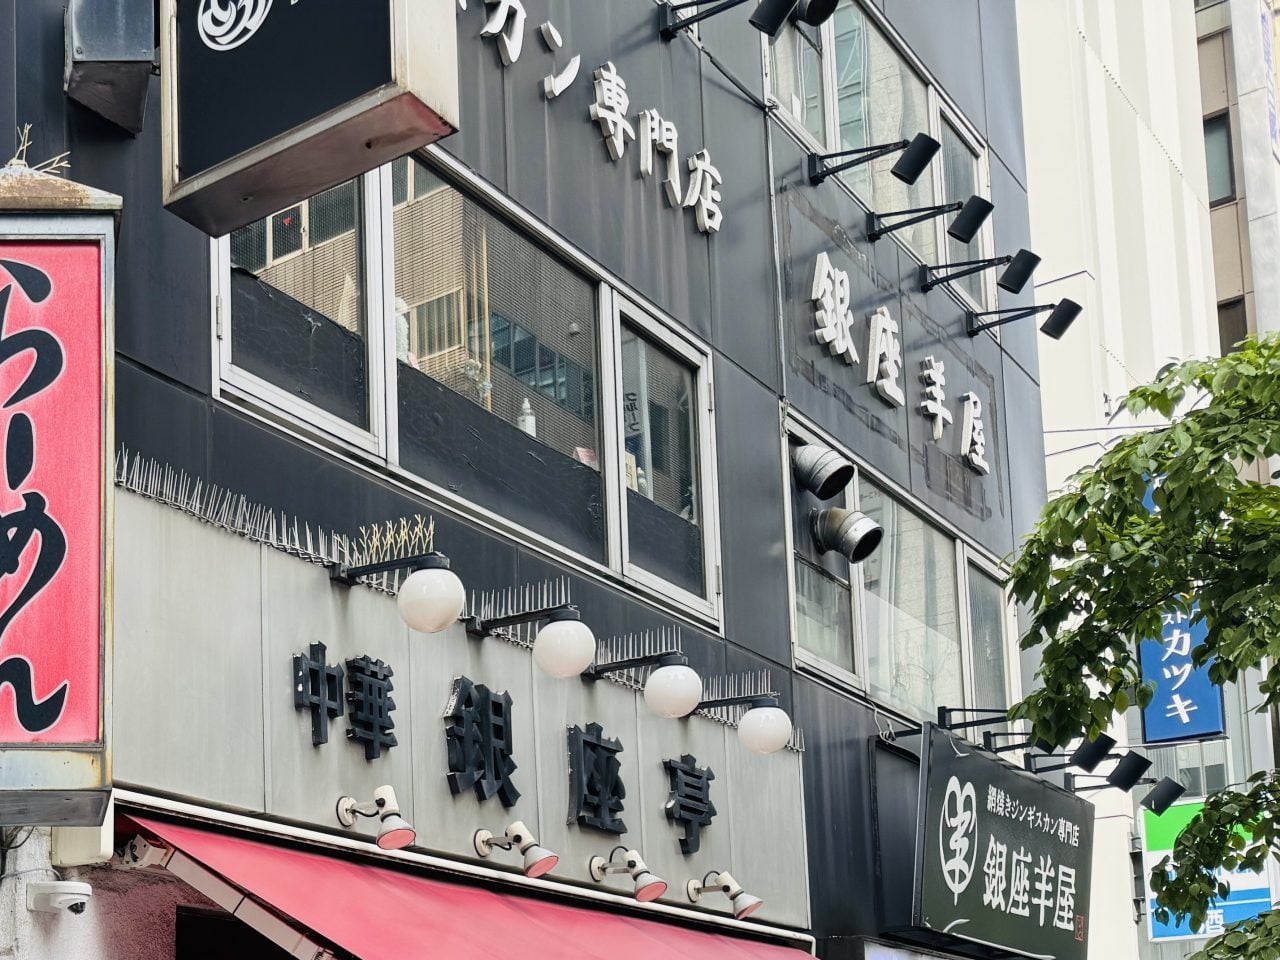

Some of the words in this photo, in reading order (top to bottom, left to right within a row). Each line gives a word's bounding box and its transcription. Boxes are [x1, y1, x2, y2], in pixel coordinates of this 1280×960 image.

[812, 251, 990, 475] 銀座羊屋
[987, 783, 1080, 848] 網焼きジンギスカン専門店
[982, 834, 1077, 932] 銀座羊屋
